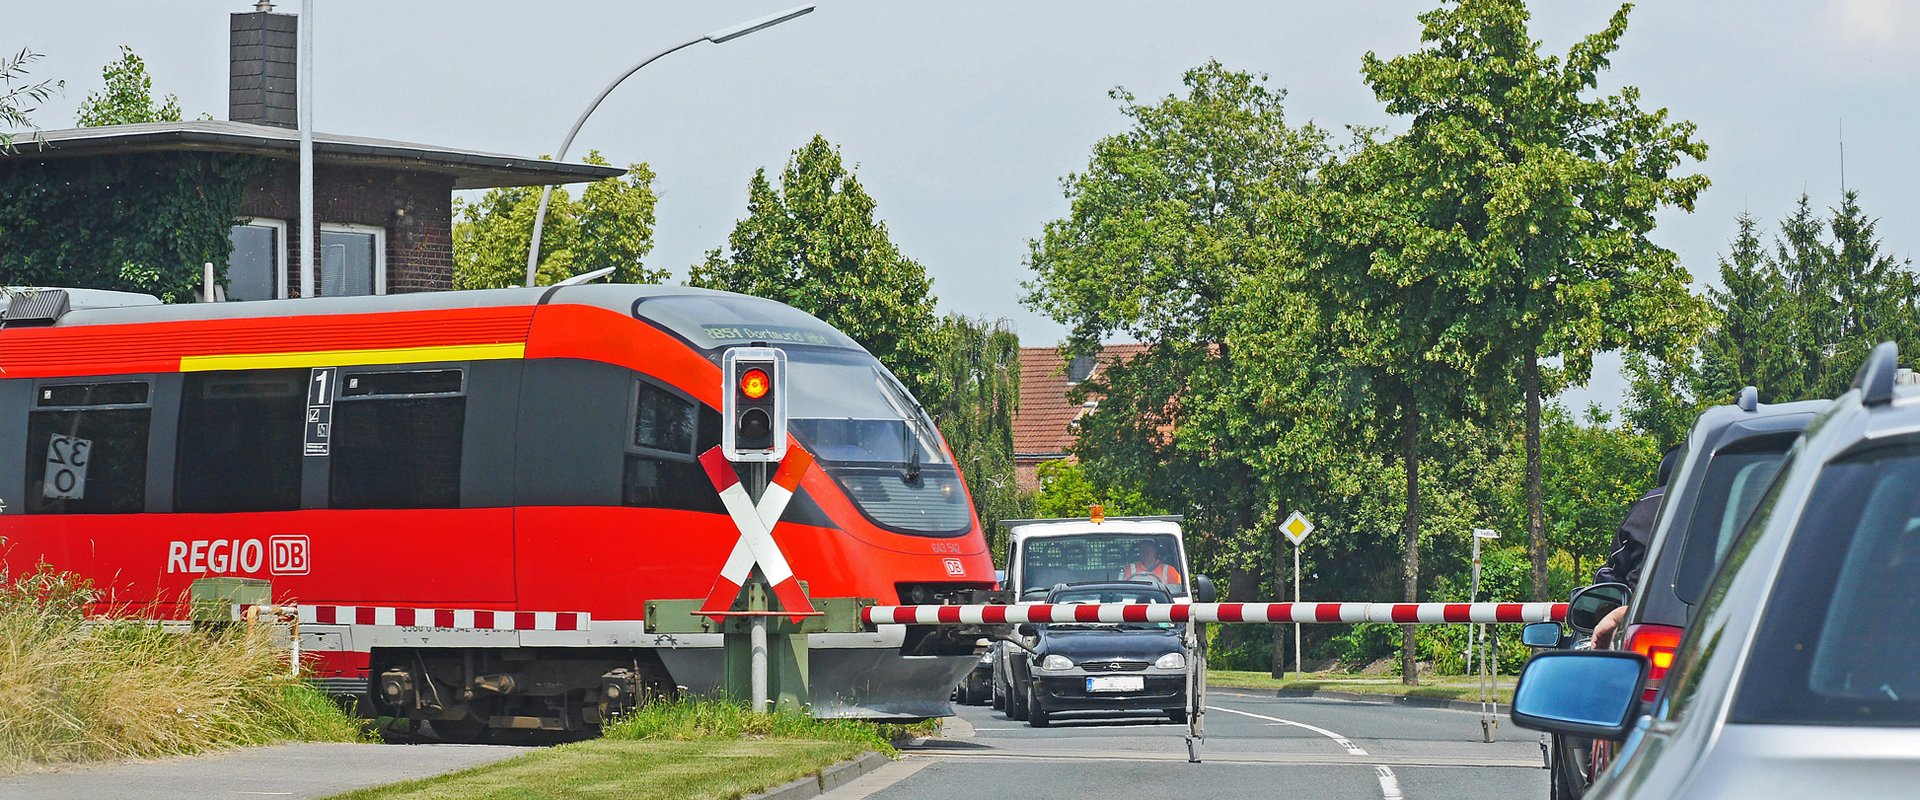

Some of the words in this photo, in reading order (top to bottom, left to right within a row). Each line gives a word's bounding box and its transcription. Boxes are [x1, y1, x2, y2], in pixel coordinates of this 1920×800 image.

[315, 371, 327, 404] 1
[167, 538, 263, 574] REGIO
[273, 540, 306, 570] DB
[946, 560, 963, 574] DB
